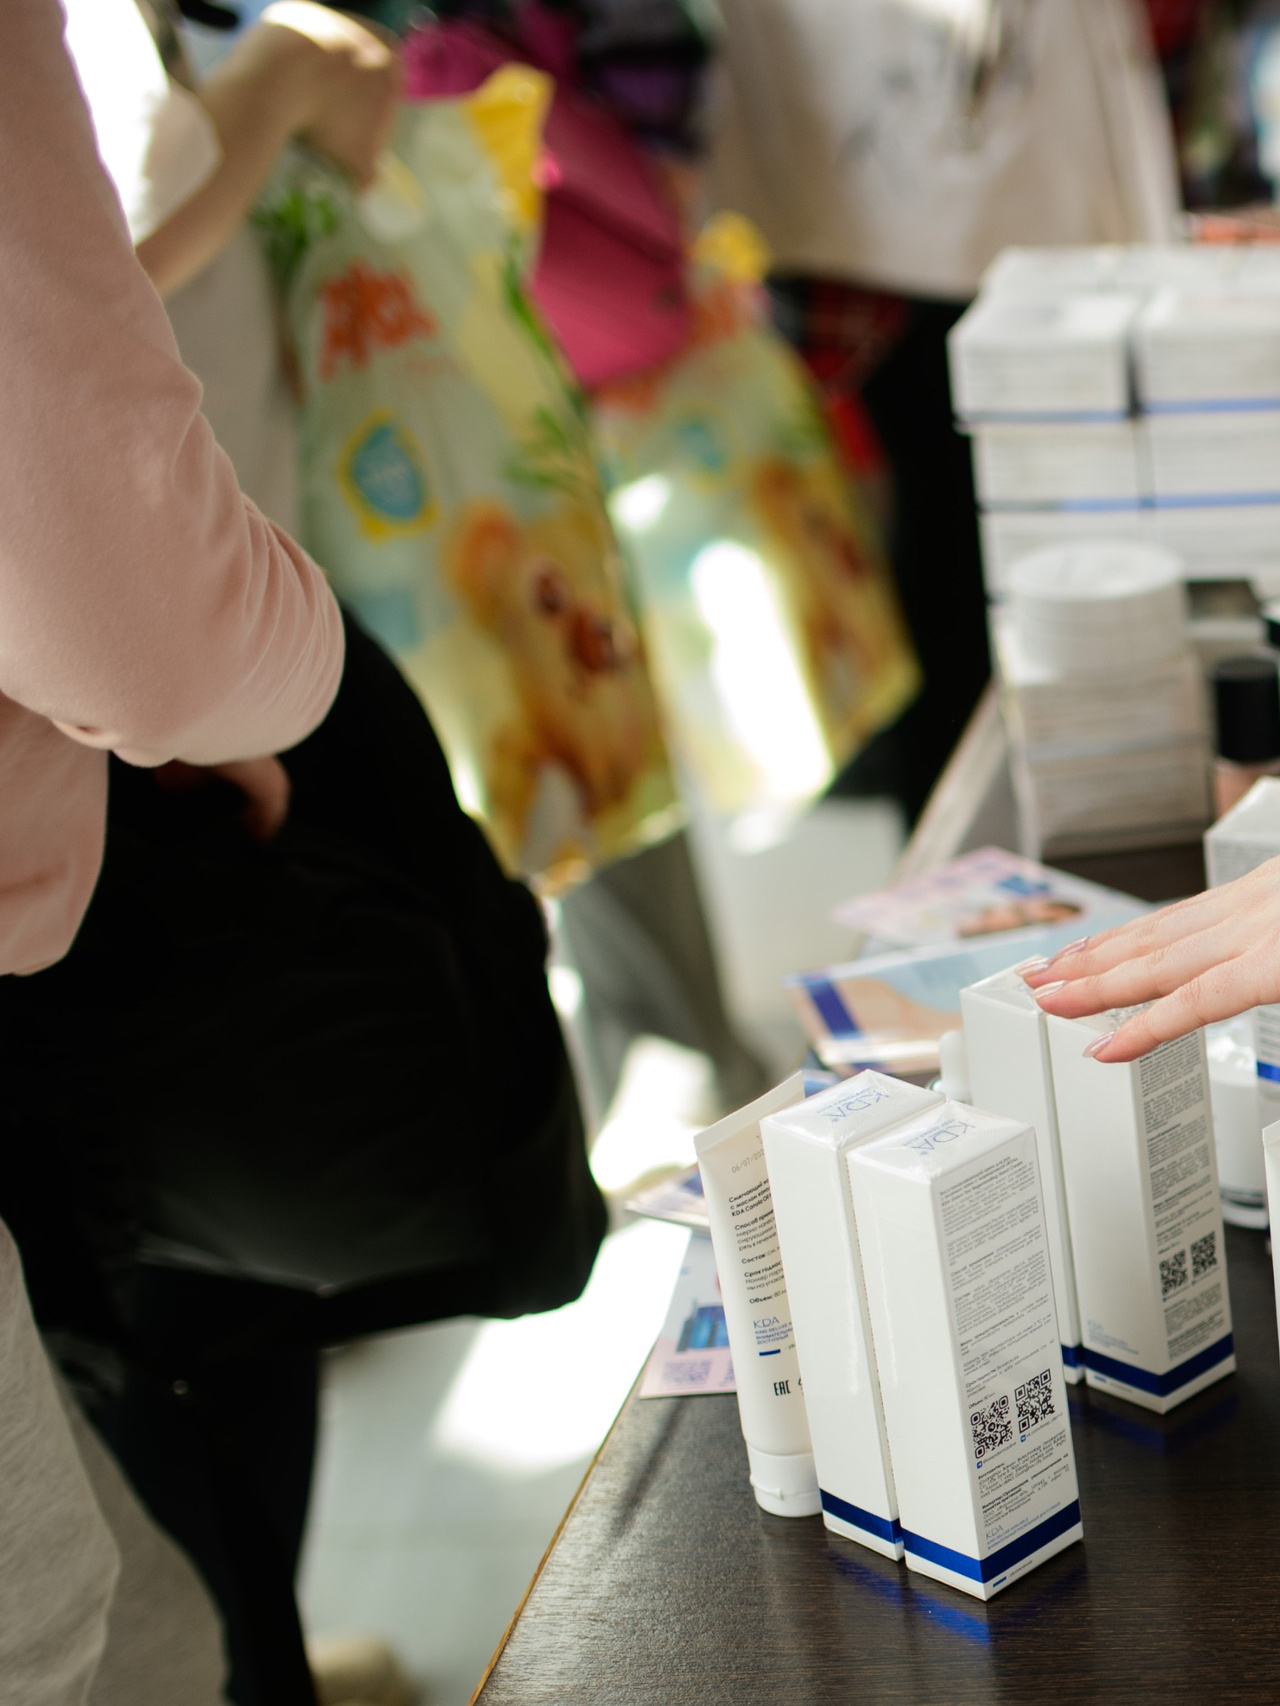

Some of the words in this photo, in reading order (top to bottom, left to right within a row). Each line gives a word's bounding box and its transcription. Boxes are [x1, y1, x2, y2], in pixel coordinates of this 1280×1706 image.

[732, 1209, 744, 1217] KDA
[753, 1317, 780, 1328] KDA
[985, 1522, 1003, 1540] KDA
